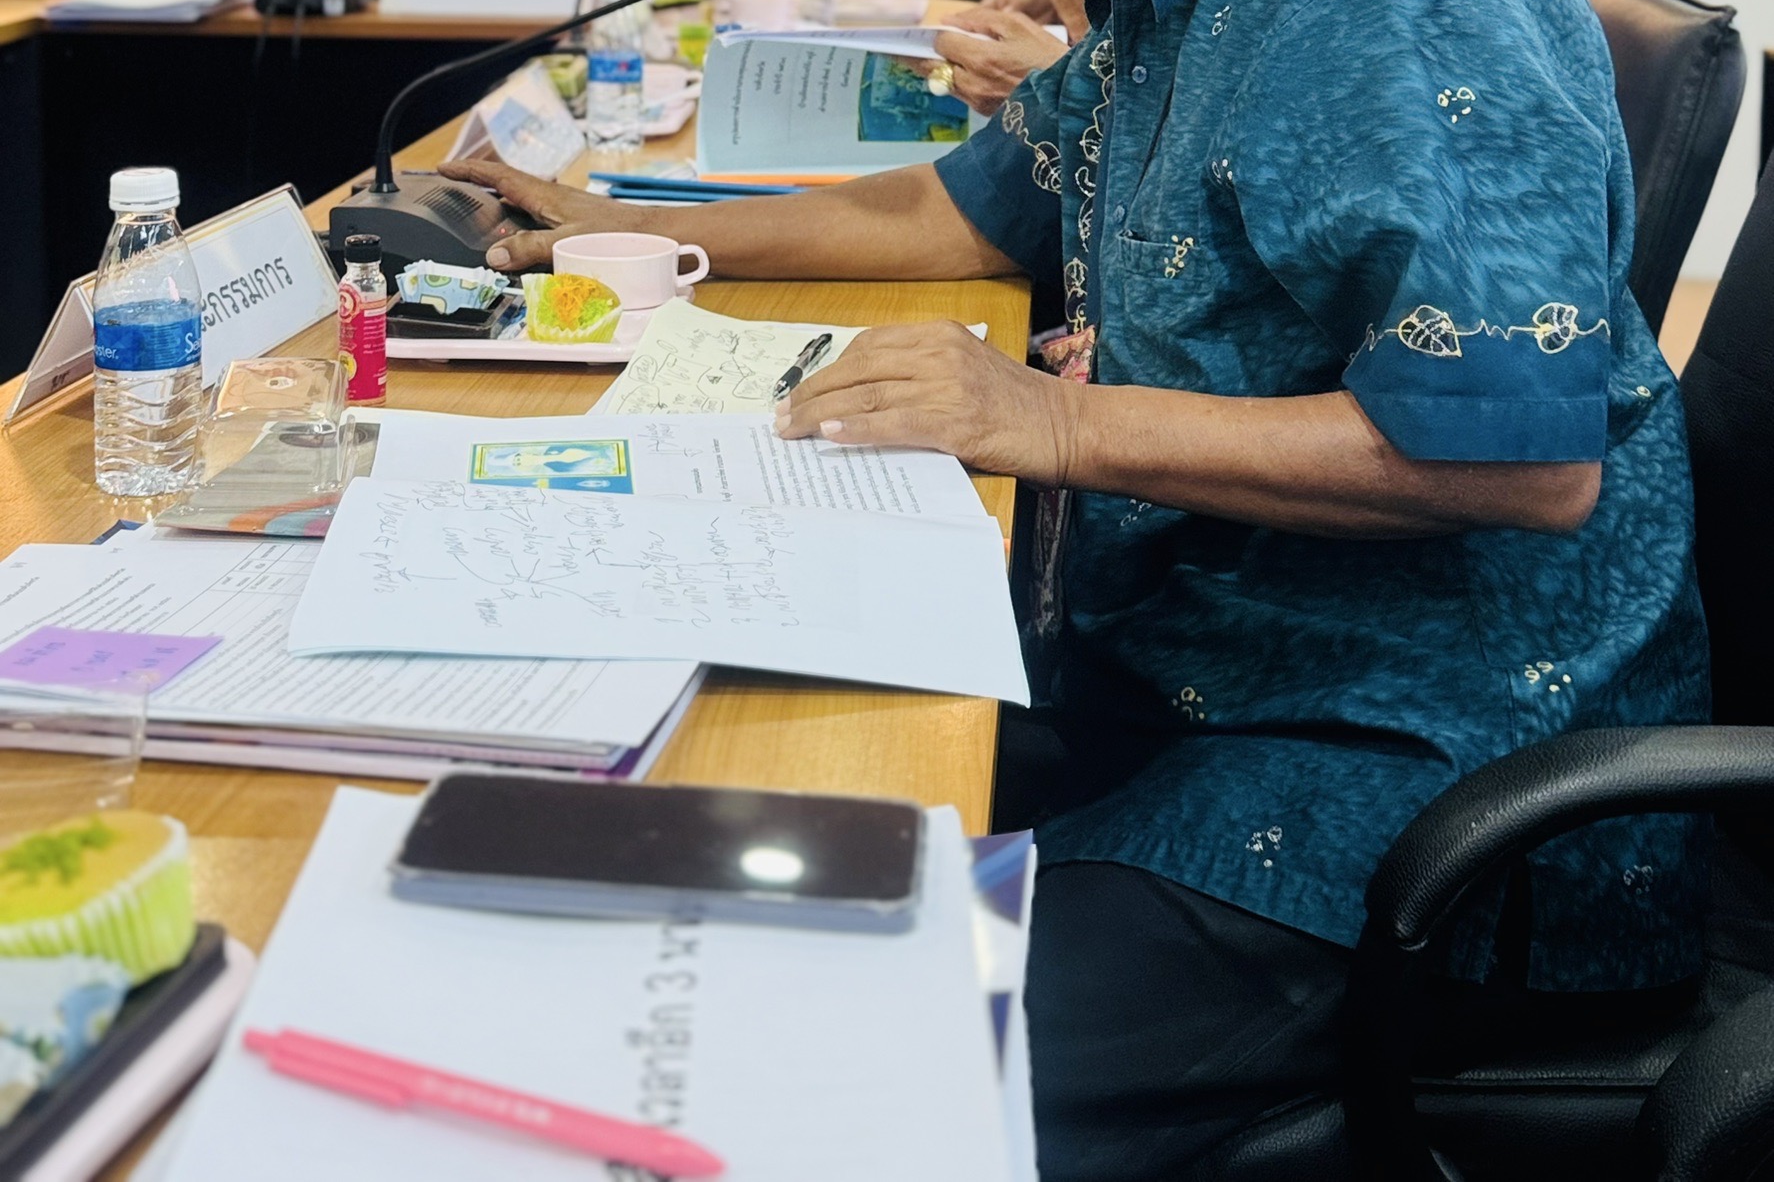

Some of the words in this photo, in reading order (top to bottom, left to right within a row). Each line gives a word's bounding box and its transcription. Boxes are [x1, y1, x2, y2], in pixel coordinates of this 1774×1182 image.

[201, 256, 292, 332] ะกรรมการ
[645, 970, 698, 992] 3
